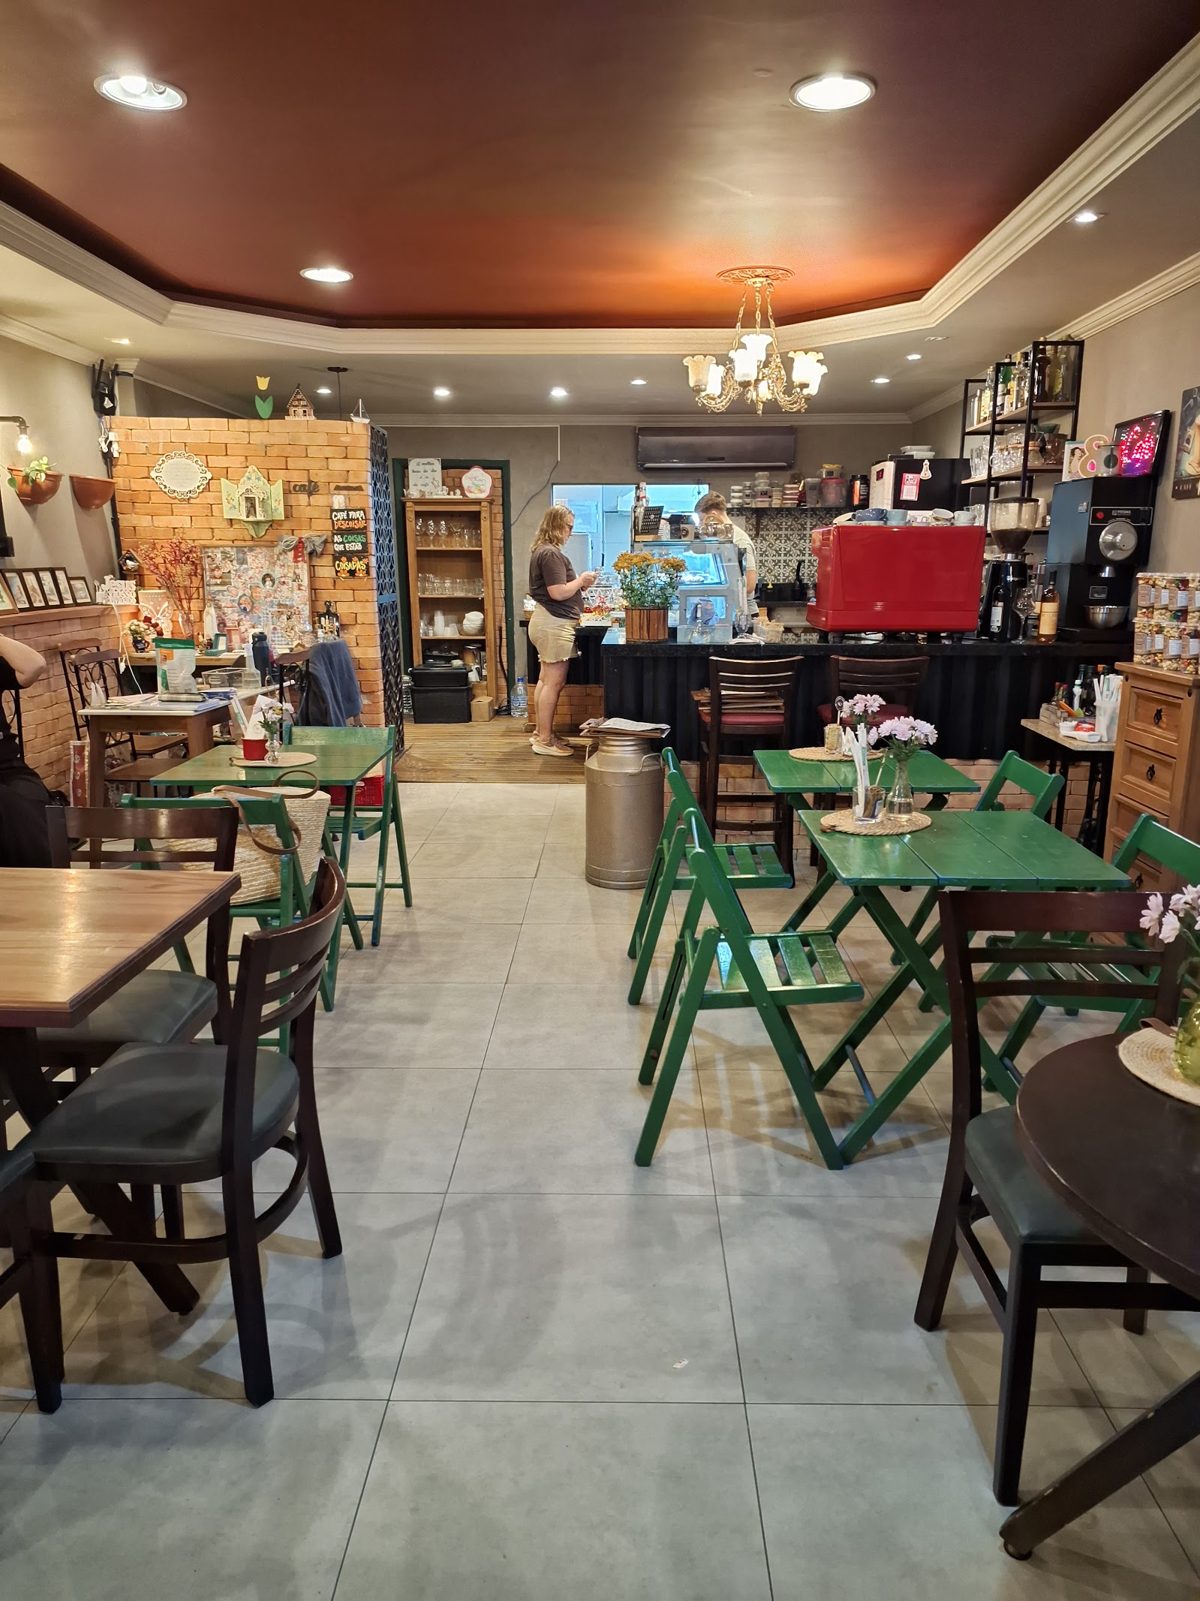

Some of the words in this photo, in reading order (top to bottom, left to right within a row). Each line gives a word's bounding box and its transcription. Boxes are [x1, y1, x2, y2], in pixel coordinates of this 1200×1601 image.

[332, 510, 347, 520] CAFÉ
[348, 510, 366, 520] PARA
[334, 534, 342, 543] AS
[343, 534, 366, 543] COISAS
[334, 543, 345, 551] QUE
[335, 560, 366, 571] COISADAS
